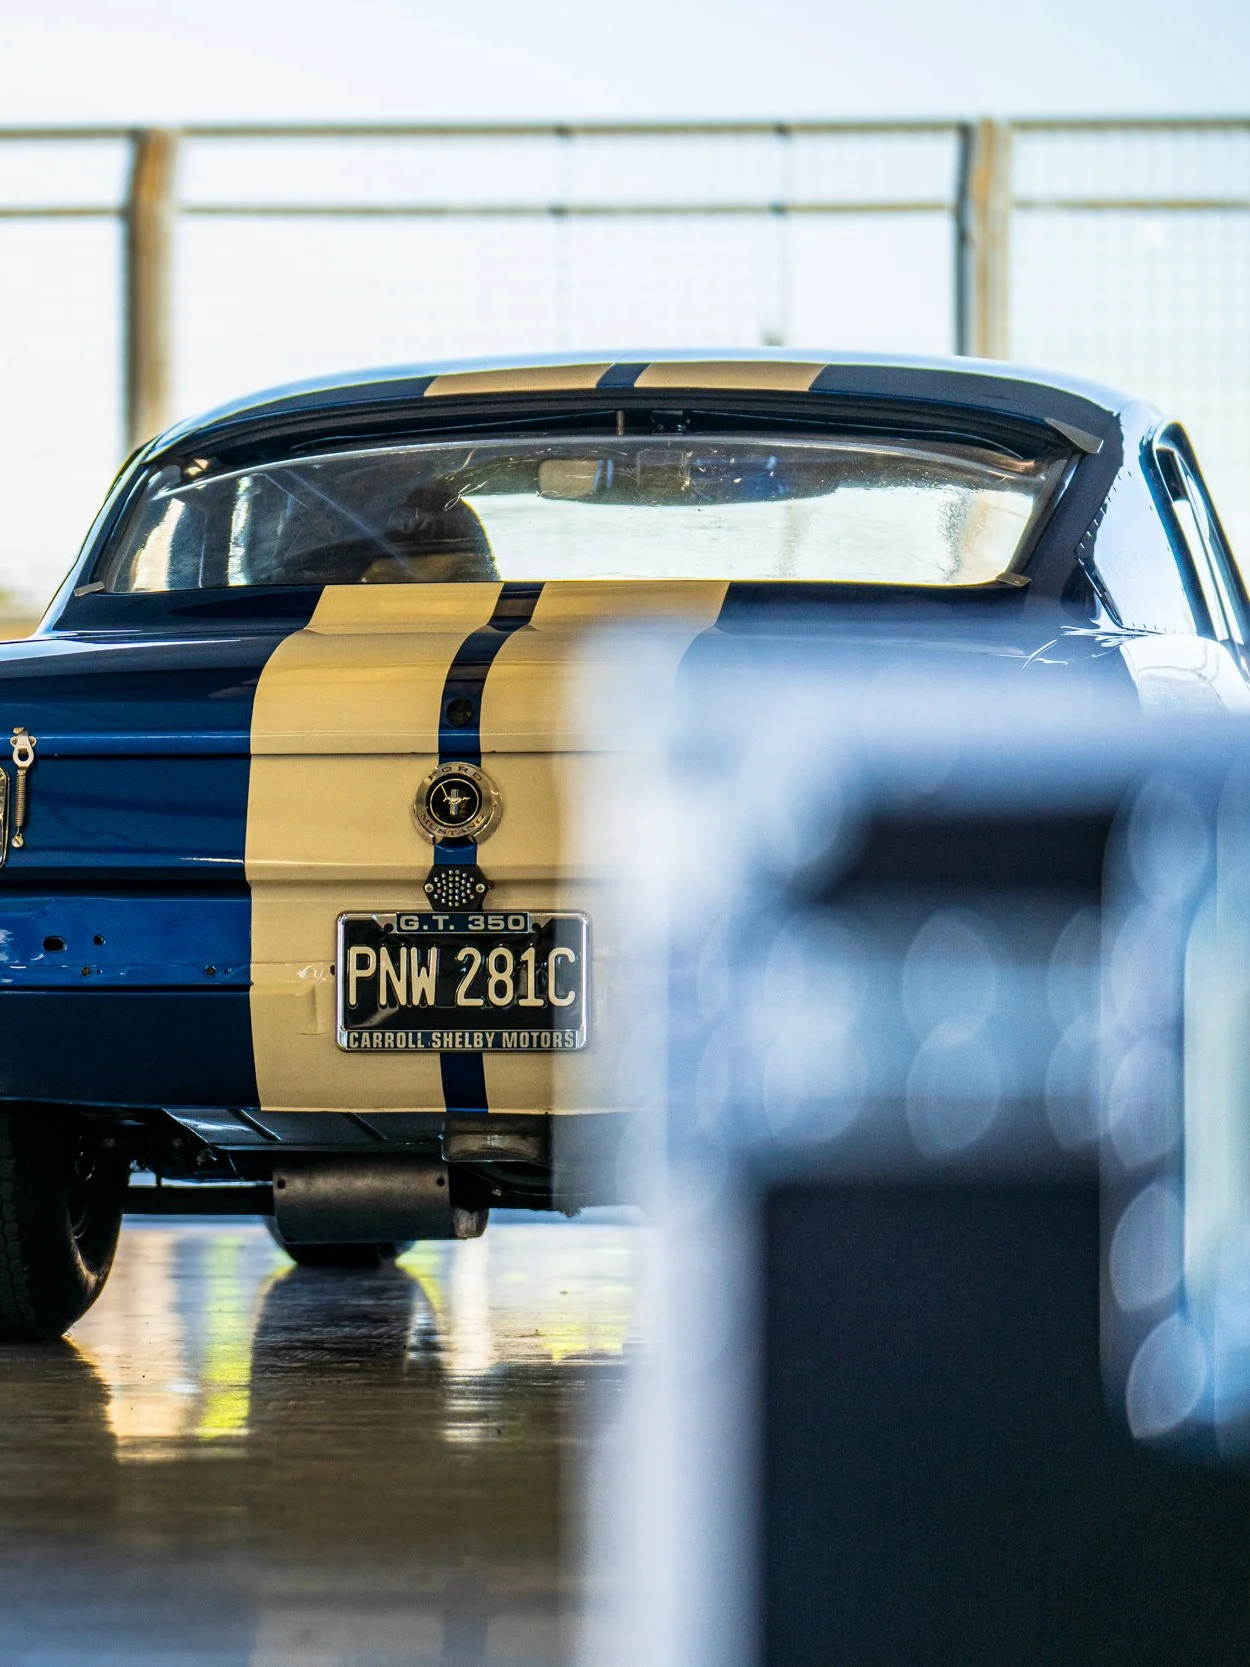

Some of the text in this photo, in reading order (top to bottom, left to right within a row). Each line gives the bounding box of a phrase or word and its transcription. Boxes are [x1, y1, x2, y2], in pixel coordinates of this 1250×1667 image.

[428, 765, 483, 782] FORD
[420, 814, 485, 836] MUSTANG
[399, 914, 526, 931] G.T. 350
[348, 946, 576, 1007] PNW 281C
[349, 1032, 575, 1048] CARROLL SHELBY MOTORS
